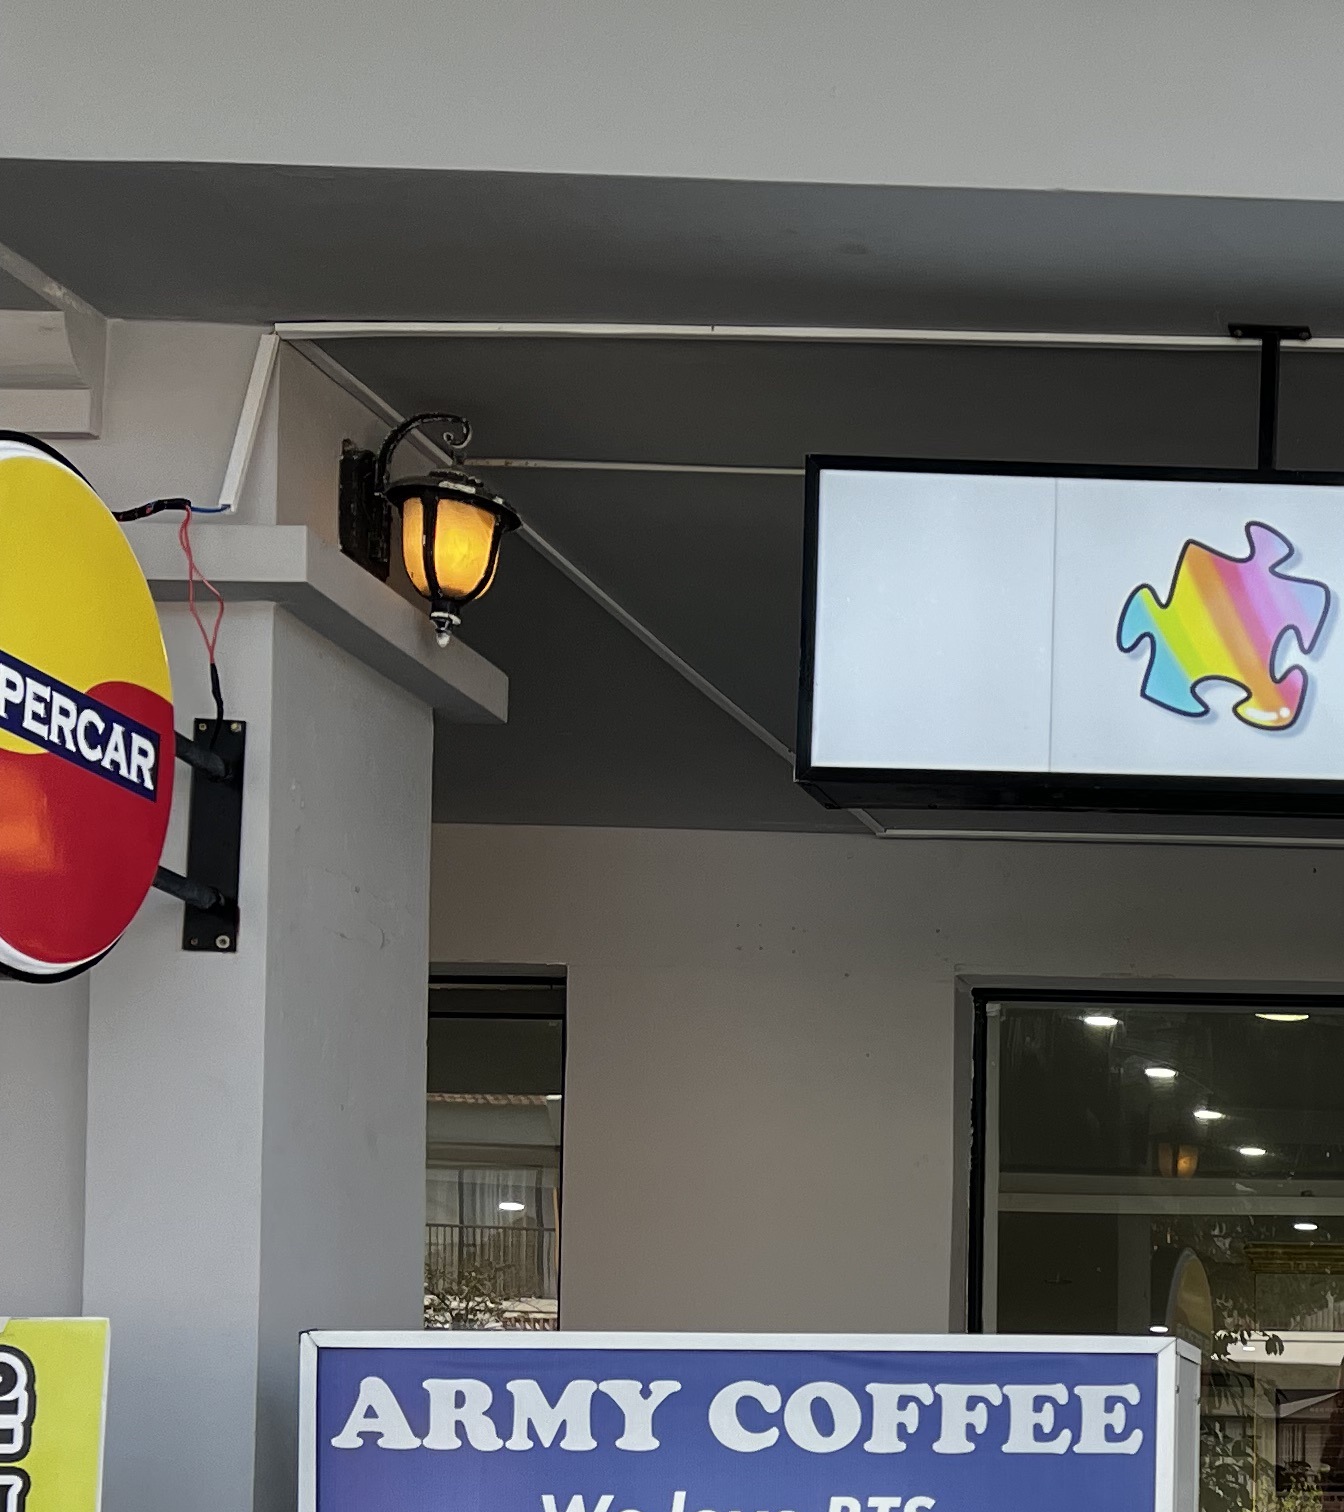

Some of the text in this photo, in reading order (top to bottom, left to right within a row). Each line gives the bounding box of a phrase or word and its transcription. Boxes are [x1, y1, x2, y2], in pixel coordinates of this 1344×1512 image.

[0, 662, 156, 790] PERCAR
[330, 1376, 1144, 1456] ARMY COFFEE
